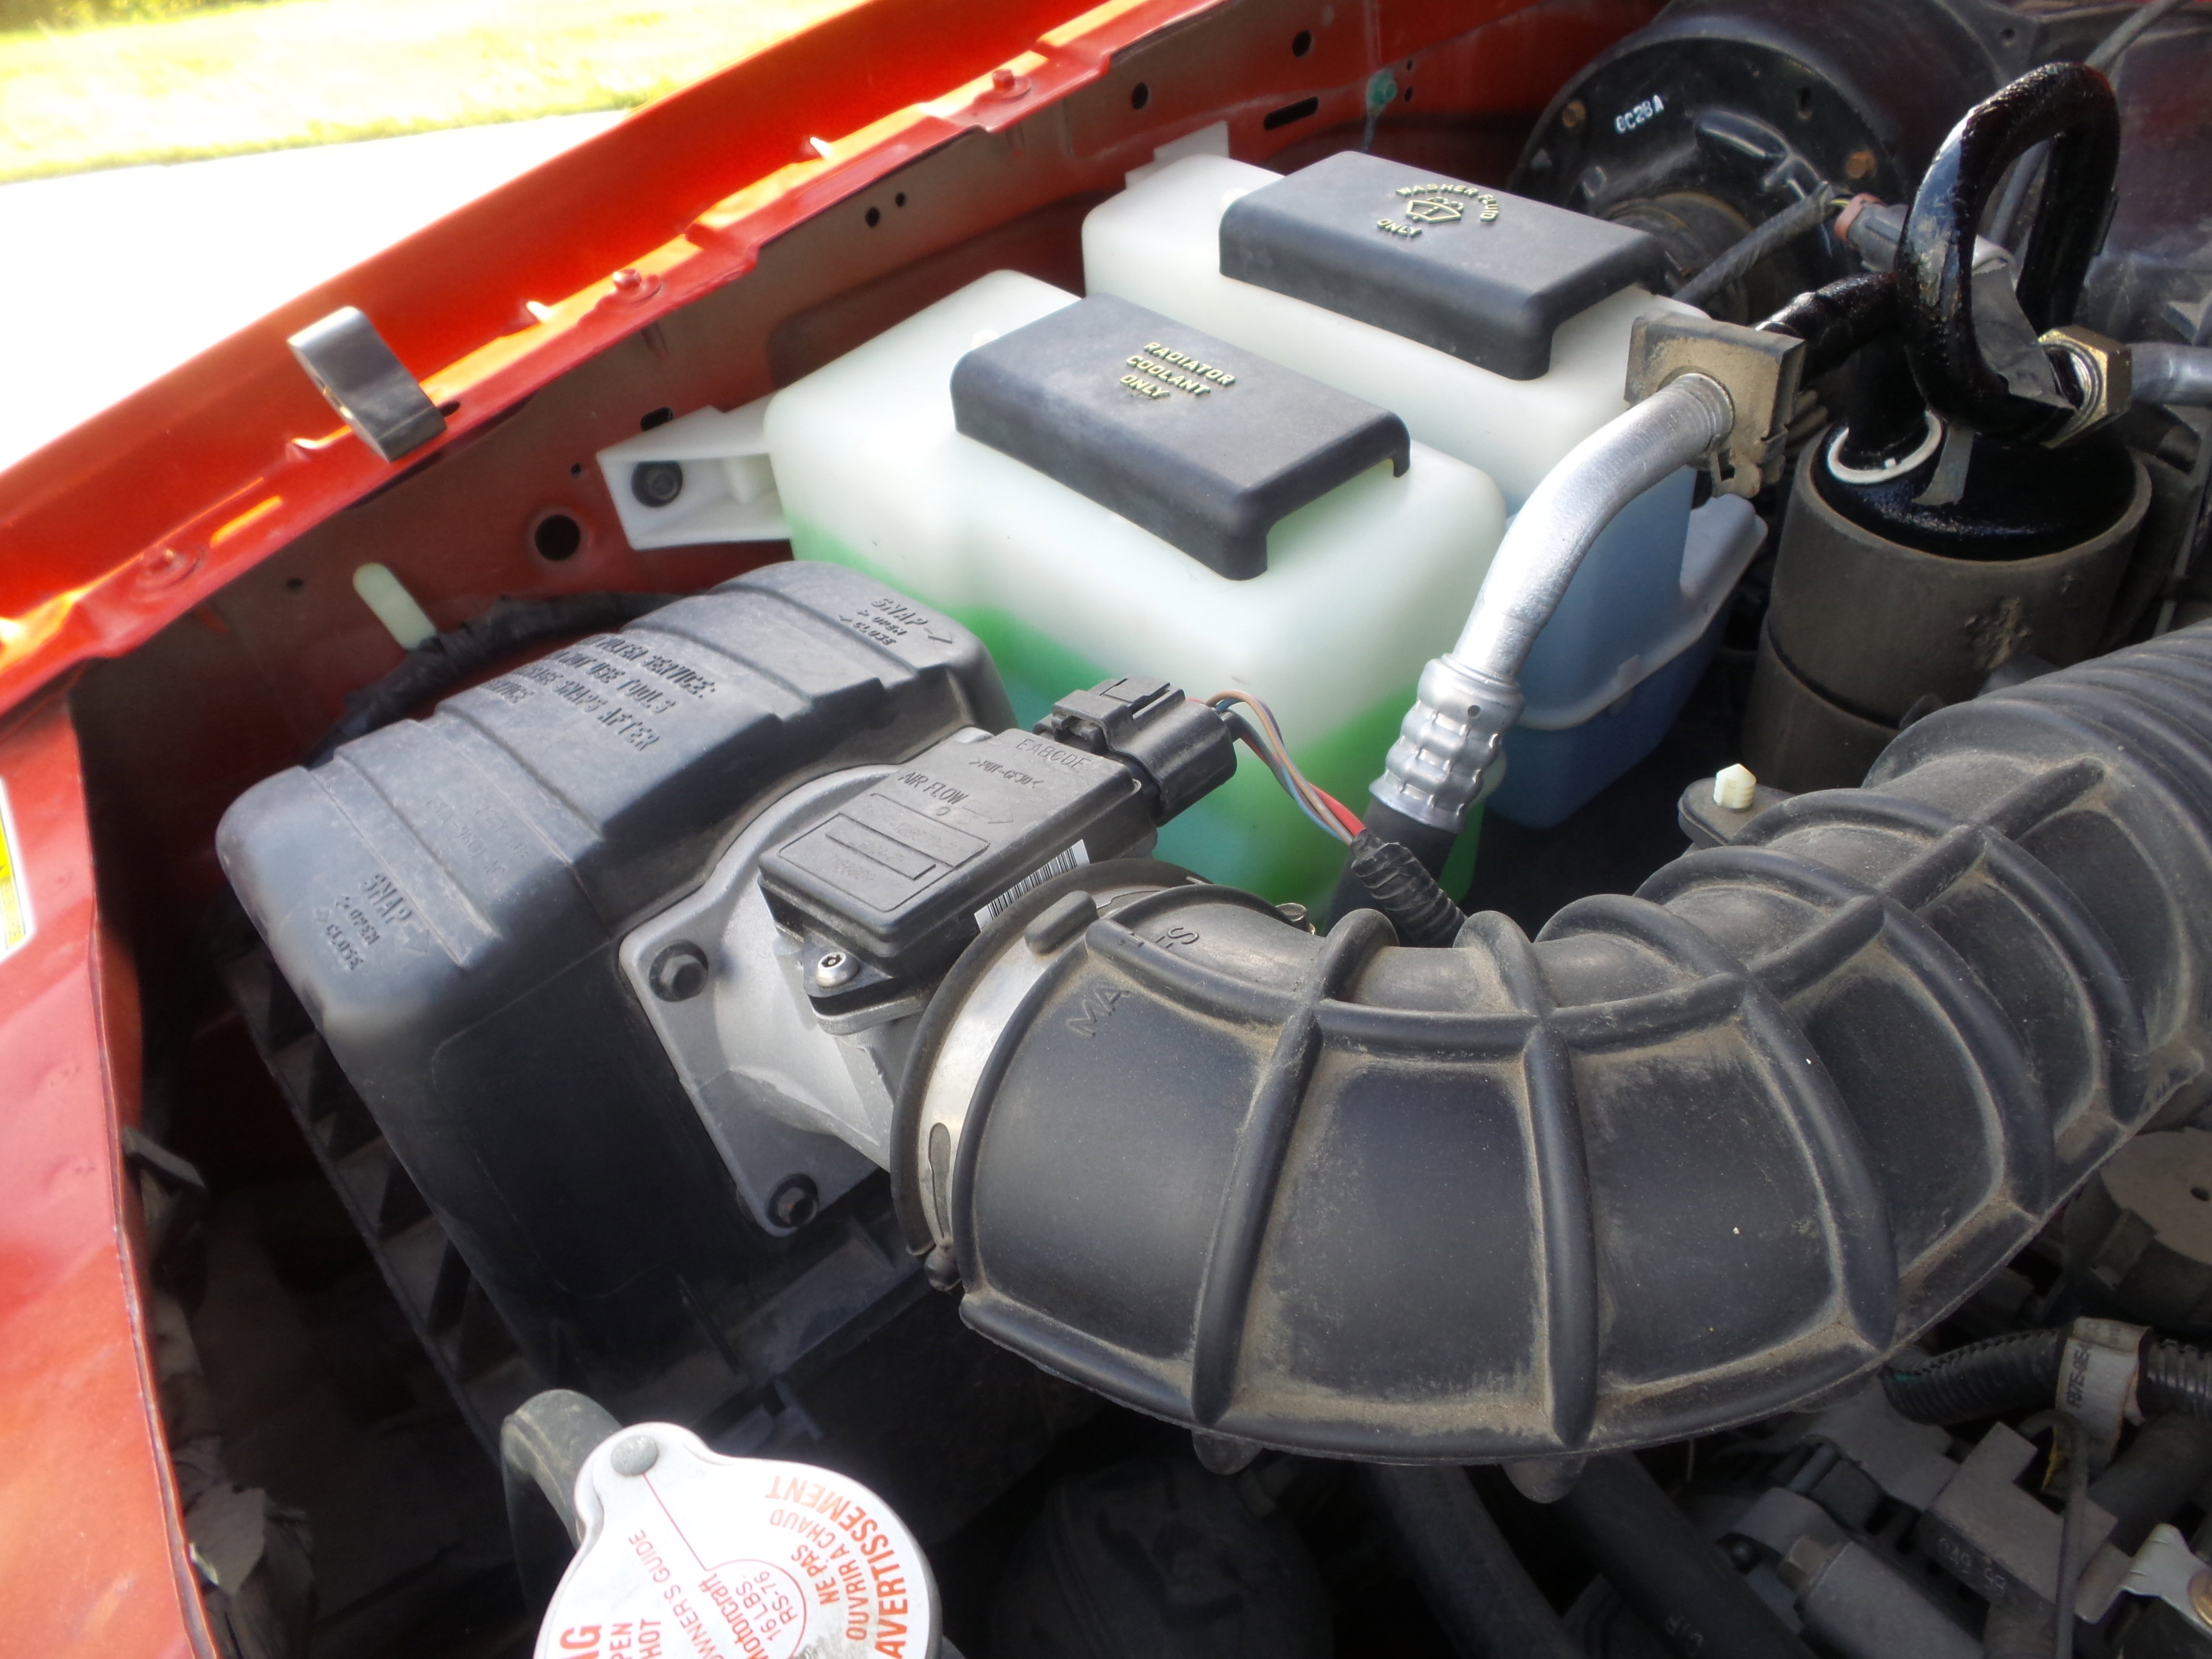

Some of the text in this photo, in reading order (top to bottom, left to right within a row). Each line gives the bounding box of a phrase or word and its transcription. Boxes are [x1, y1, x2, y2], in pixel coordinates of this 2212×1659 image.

[1395, 183, 1500, 222] WASHER FLUID
[1377, 218, 1422, 238] ONLY
[1126, 354, 1211, 397] COOLANT
[1144, 341, 1236, 387] RADIATOR
[1120, 374, 1170, 399] ONLY
[871, 598, 928, 625] SNAP
[616, 679, 676, 714] TOOLS
[596, 707, 660, 751] AFTER
[898, 771, 969, 805] AIR FLOW
[770, 1509, 836, 1549] CHAUD
[765, 1475, 908, 1659] AVERTISSEMENT
[791, 1544, 840, 1606] NE PAS
[628, 1528, 724, 1659] WNER'S GUIDE
[754, 1571, 798, 1624] RS-76
[845, 1560, 870, 1641] OUVRIR
[638, 1618, 662, 1659] HOT
[760, 1618, 781, 1642] 16
